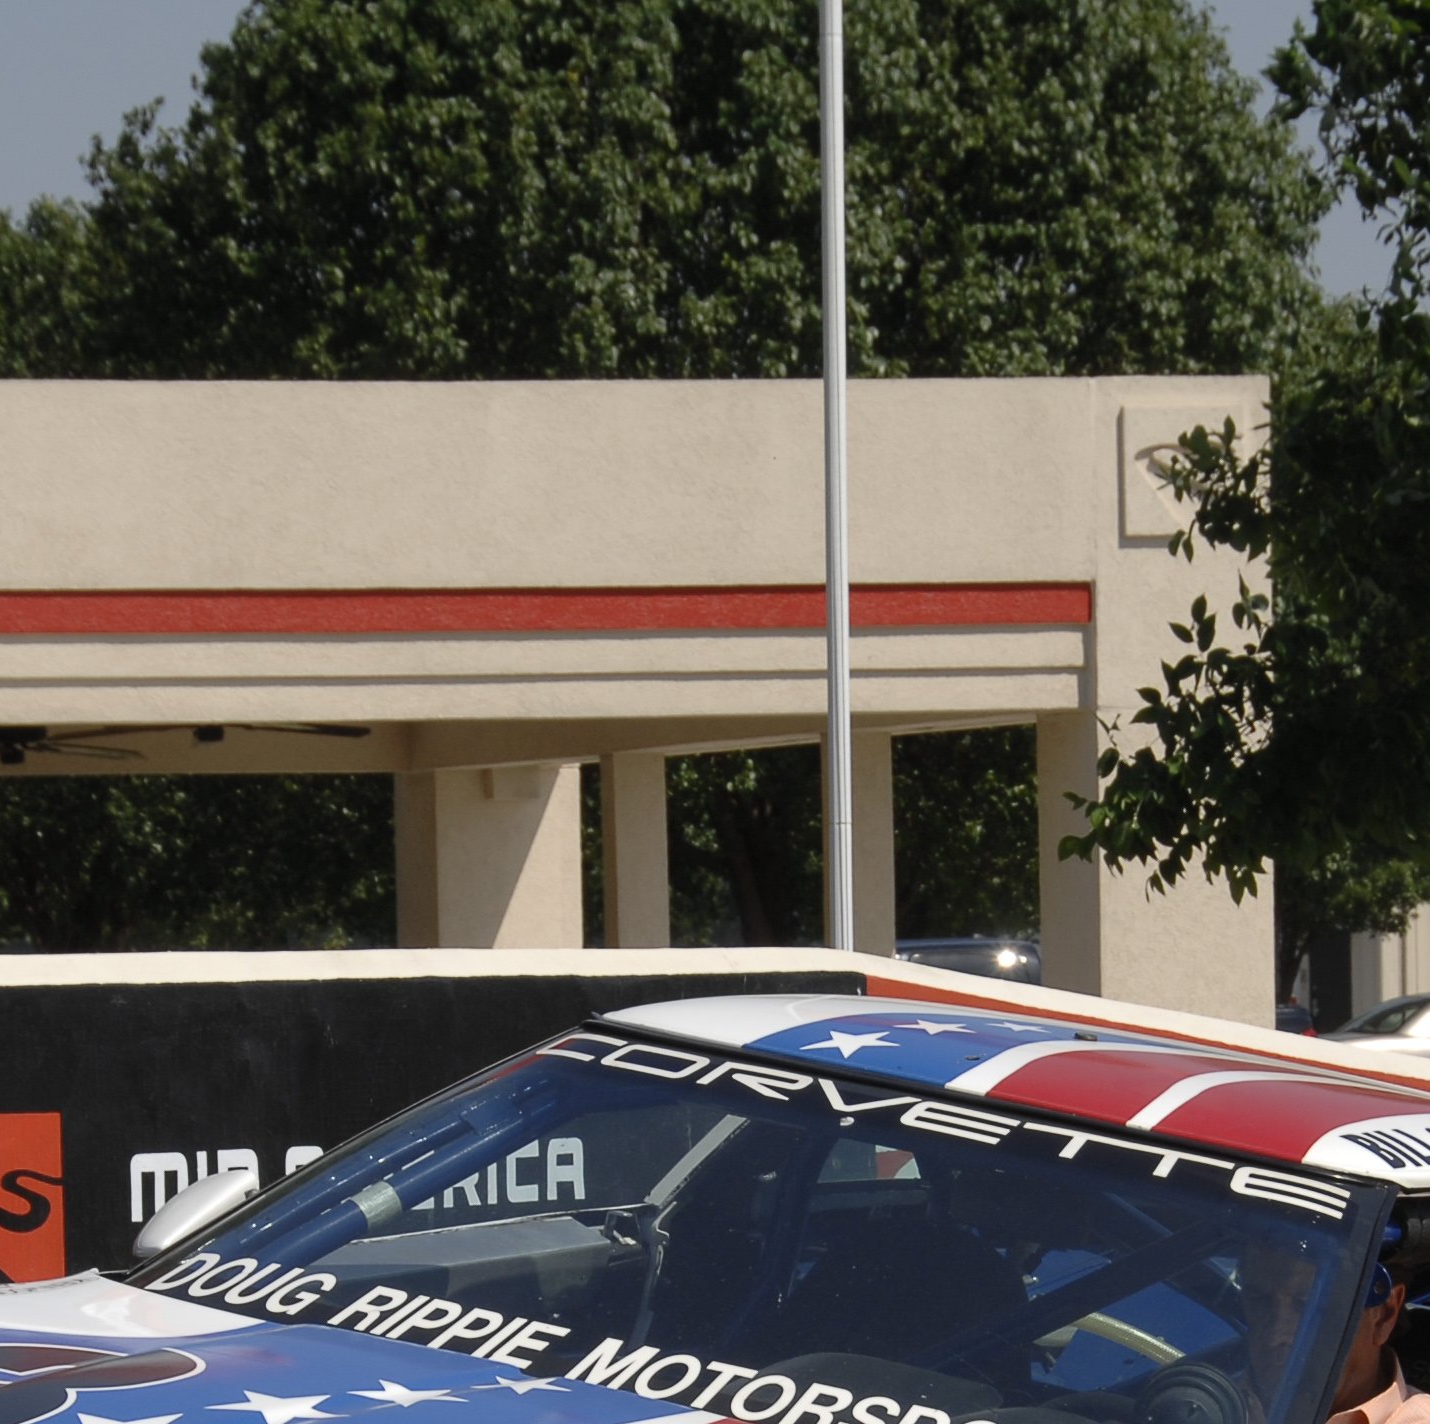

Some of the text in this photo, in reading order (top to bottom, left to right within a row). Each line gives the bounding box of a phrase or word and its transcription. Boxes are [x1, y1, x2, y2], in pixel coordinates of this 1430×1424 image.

[537, 1033, 1350, 1220] CORVETTE
[146, 1253, 334, 1317] DOUG
[327, 1281, 571, 1371] RIPPIE
